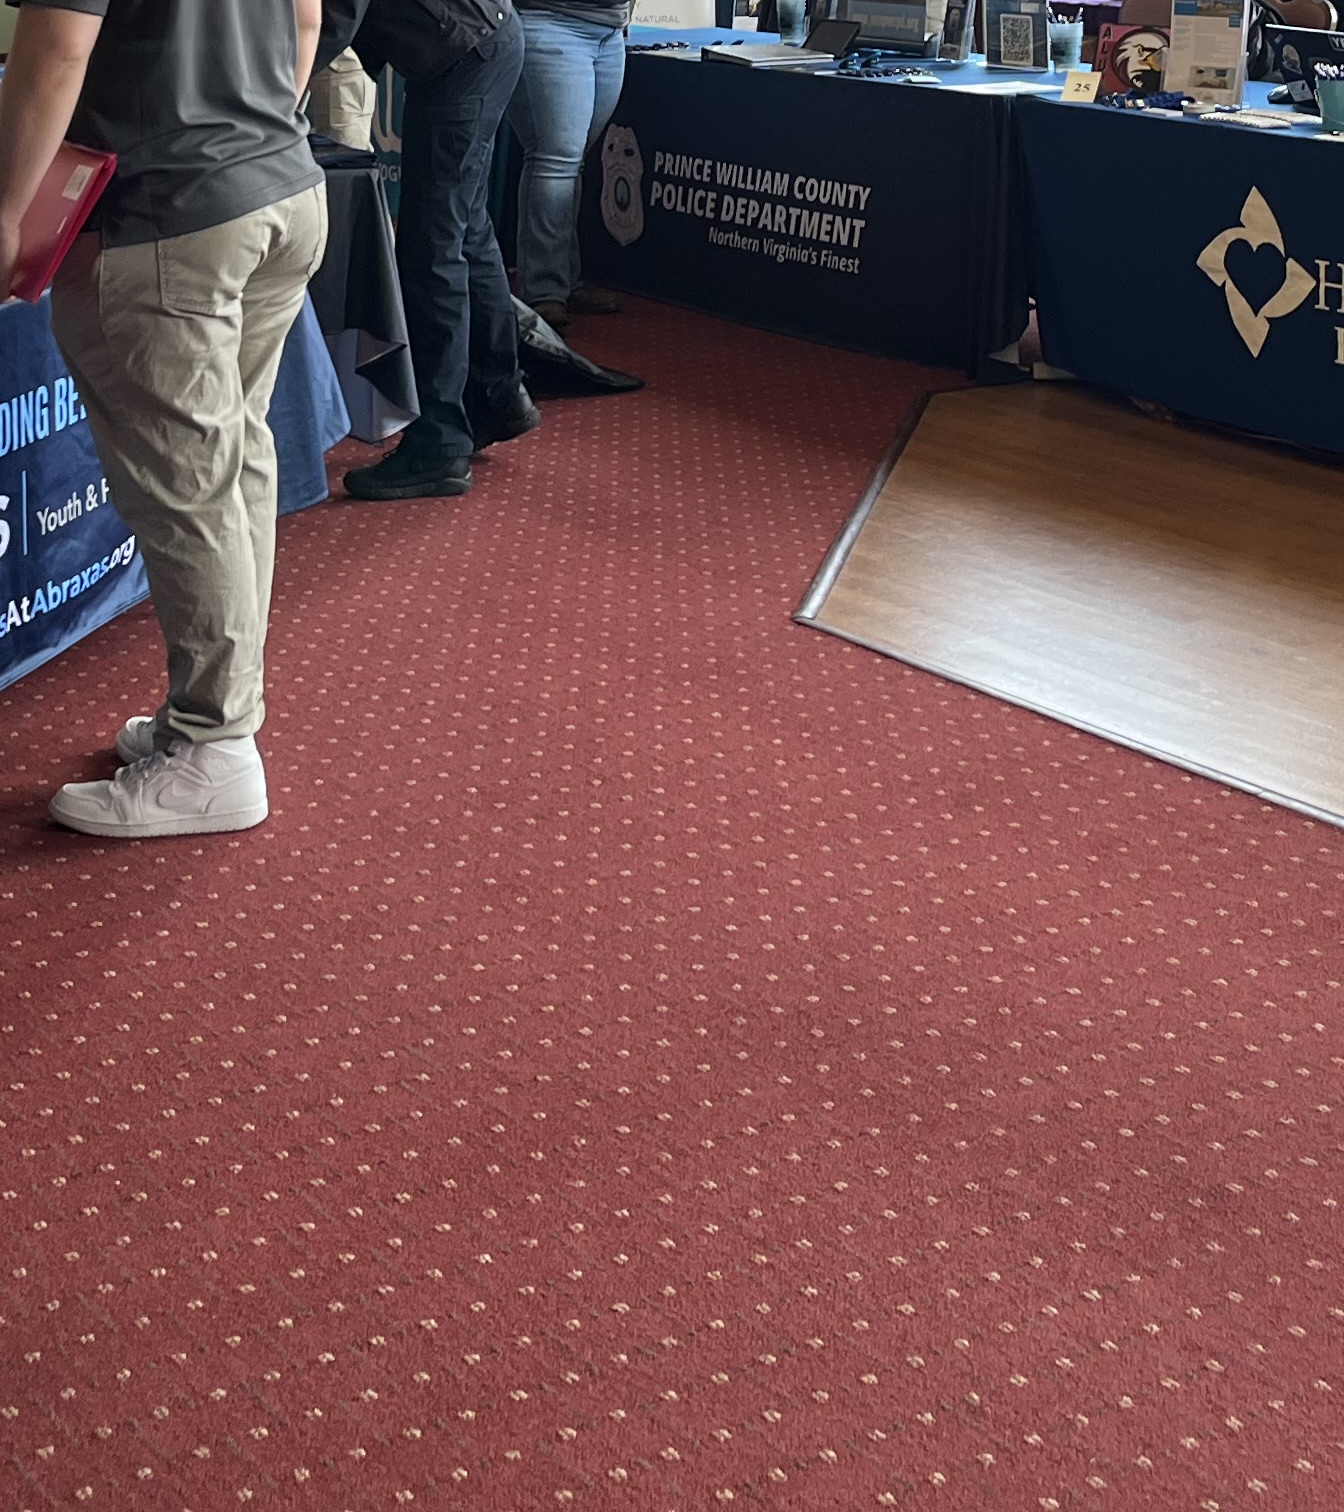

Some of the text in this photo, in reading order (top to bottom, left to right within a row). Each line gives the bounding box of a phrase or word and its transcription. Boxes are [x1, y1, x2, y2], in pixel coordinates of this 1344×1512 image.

[635, 15, 680, 24] NATURAL
[1074, 83, 1091, 92] 25
[654, 150, 871, 212] PRINCE WILLIAM COUNTY
[650, 180, 866, 249] POLICE DEPARTMENT
[708, 225, 860, 275] Northern Virginia's Finest
[54, 375, 87, 432] BE
[36, 493, 82, 536] Youth
[85, 484, 98, 513] &
